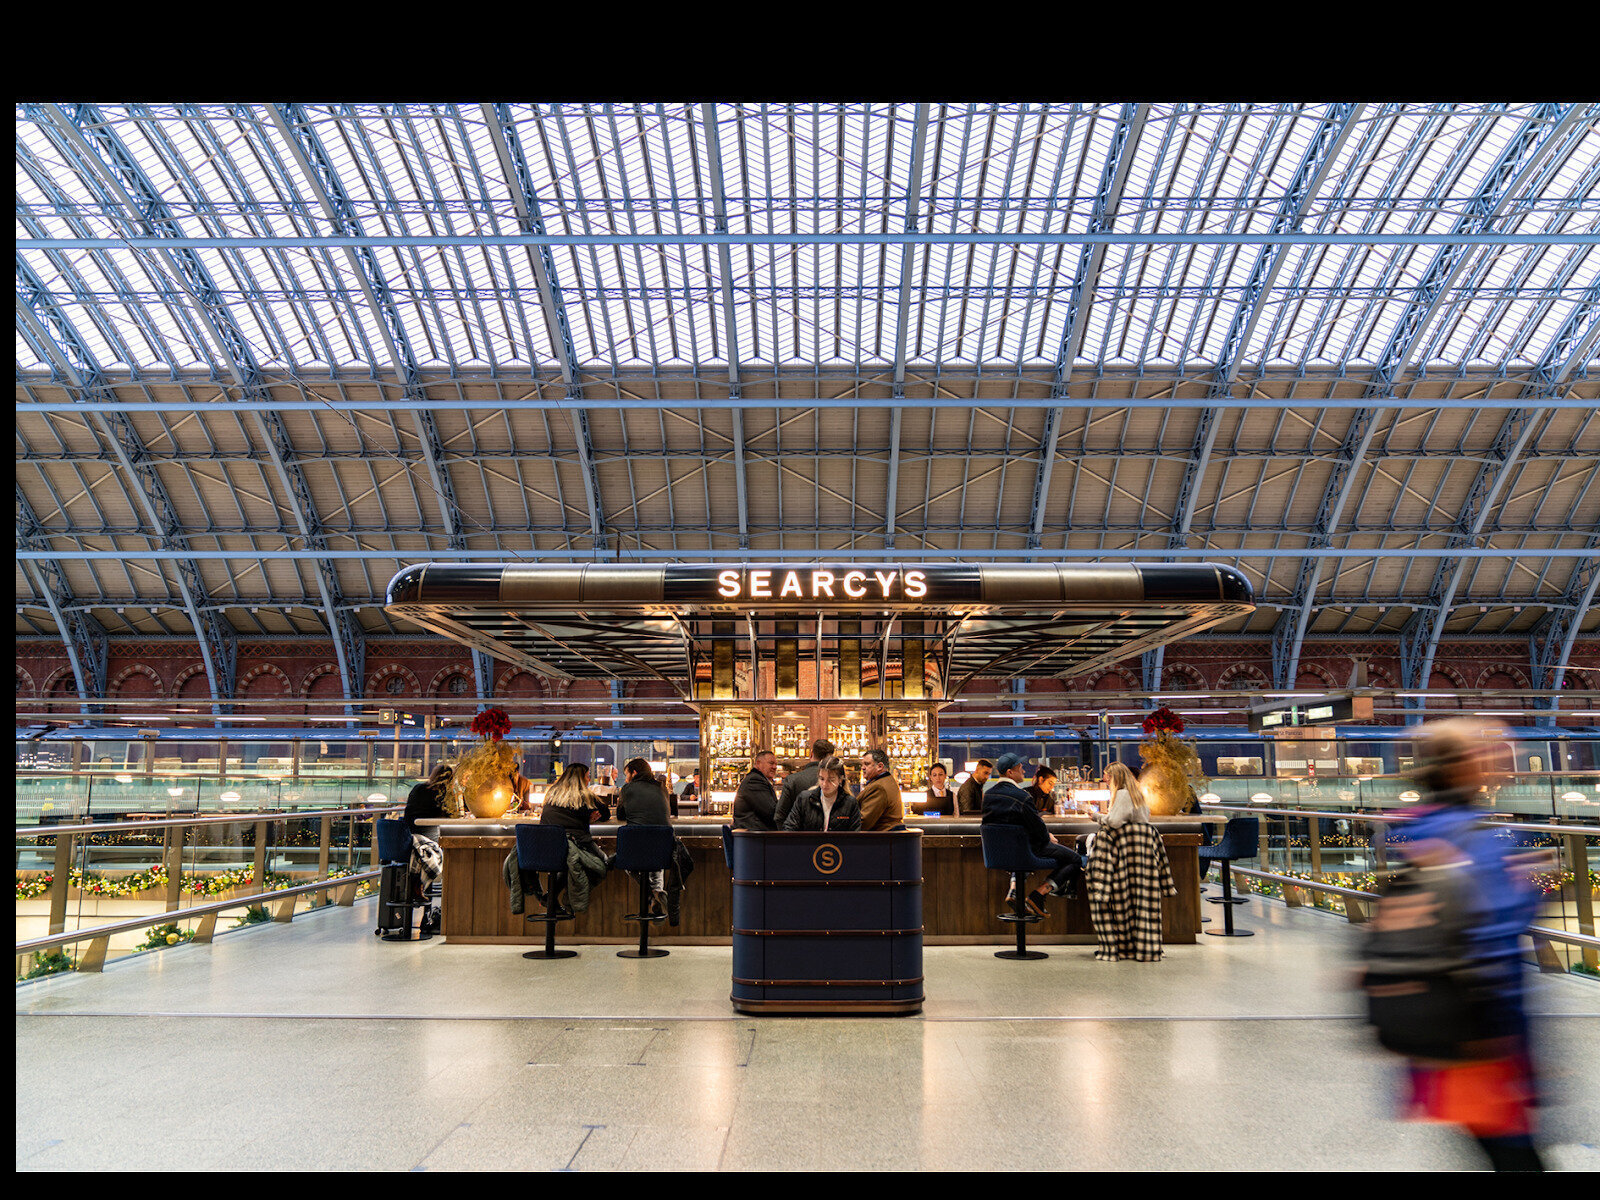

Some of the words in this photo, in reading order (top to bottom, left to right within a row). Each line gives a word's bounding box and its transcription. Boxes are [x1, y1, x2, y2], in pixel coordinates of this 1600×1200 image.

[717, 570, 928, 598] SEARCYS
[383, 712, 390, 721] 5
[1320, 730, 1331, 752] 5
